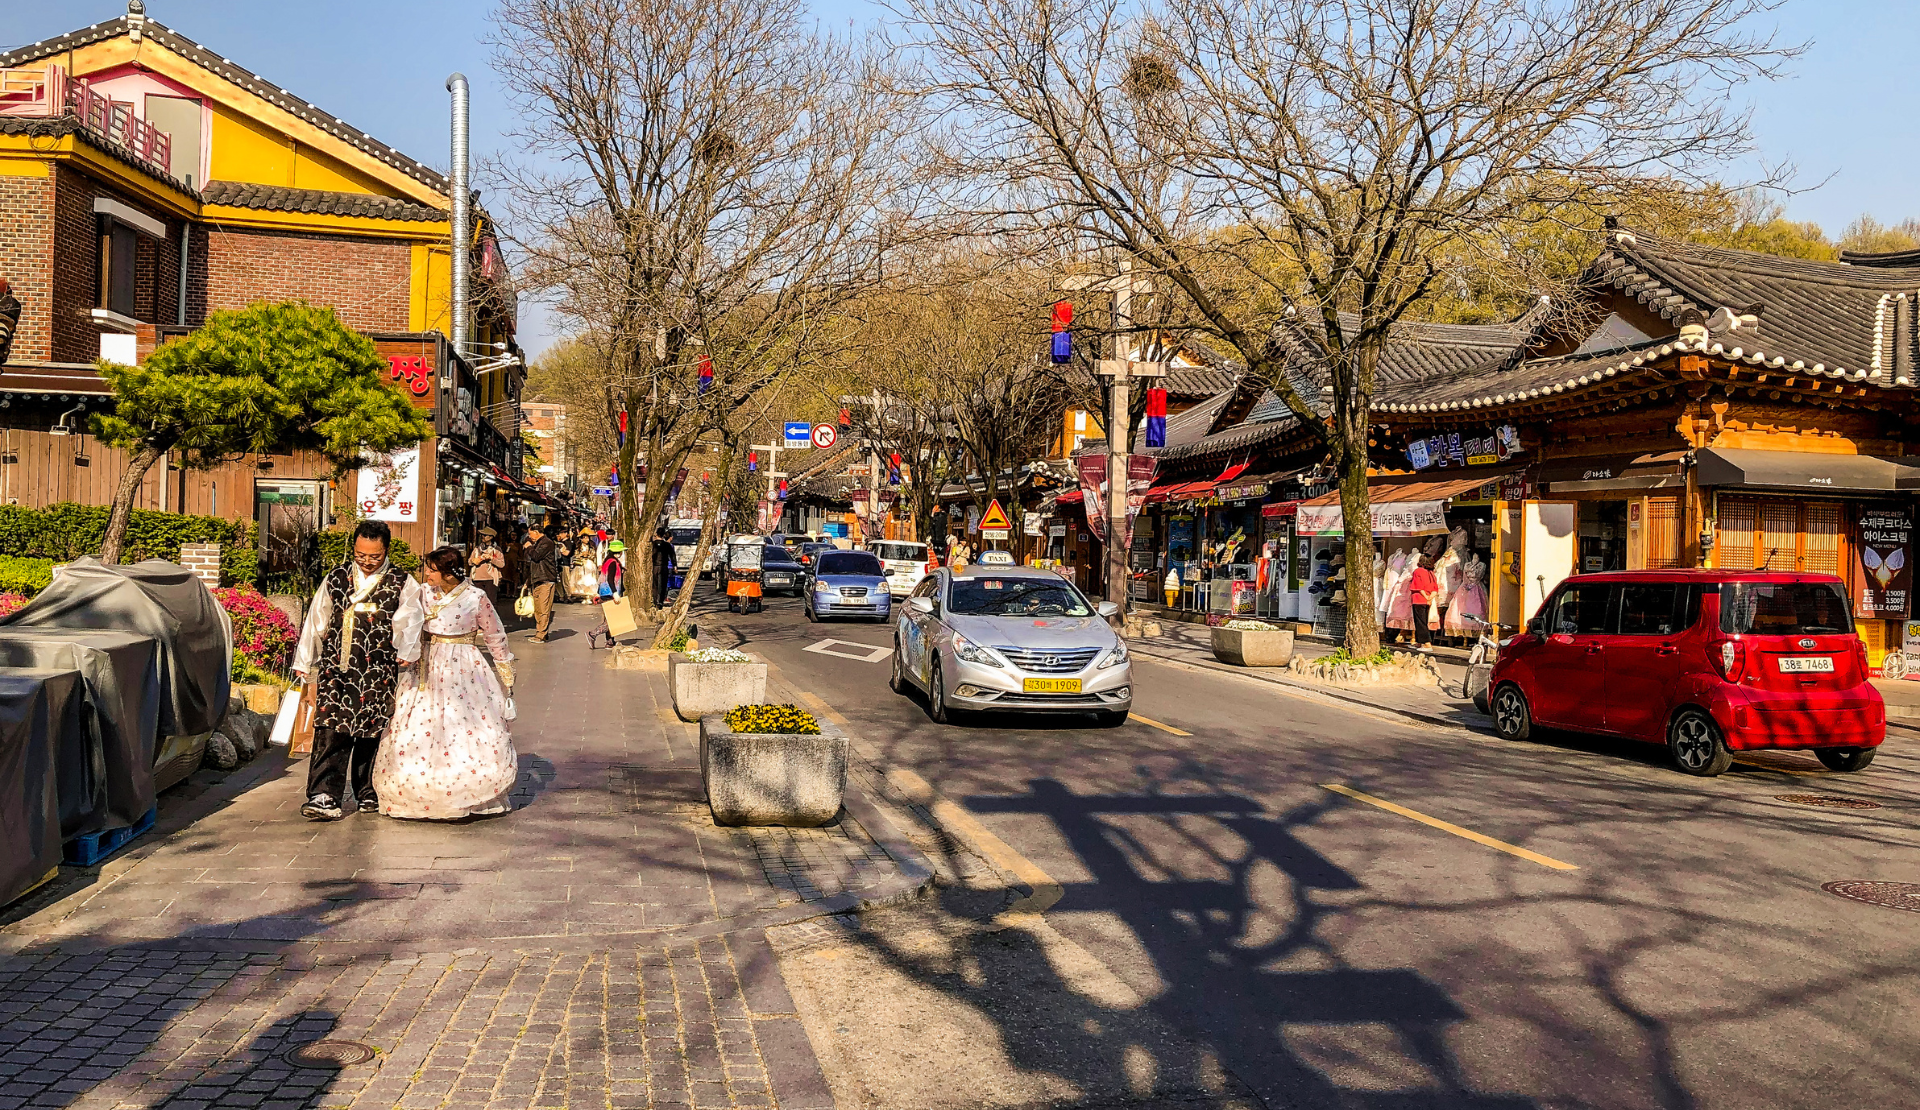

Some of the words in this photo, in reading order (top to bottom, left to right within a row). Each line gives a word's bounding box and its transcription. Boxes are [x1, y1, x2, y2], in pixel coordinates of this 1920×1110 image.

[387, 355, 434, 394] 짱
[363, 501, 376, 513] 오
[399, 501, 413, 515] 짱
[1859, 518, 1912, 529] 수제쿠크다스
[1863, 530, 1908, 543] 아이스크림
[1805, 660, 1829, 669] 7468
[1055, 681, 1078, 690] 1909
